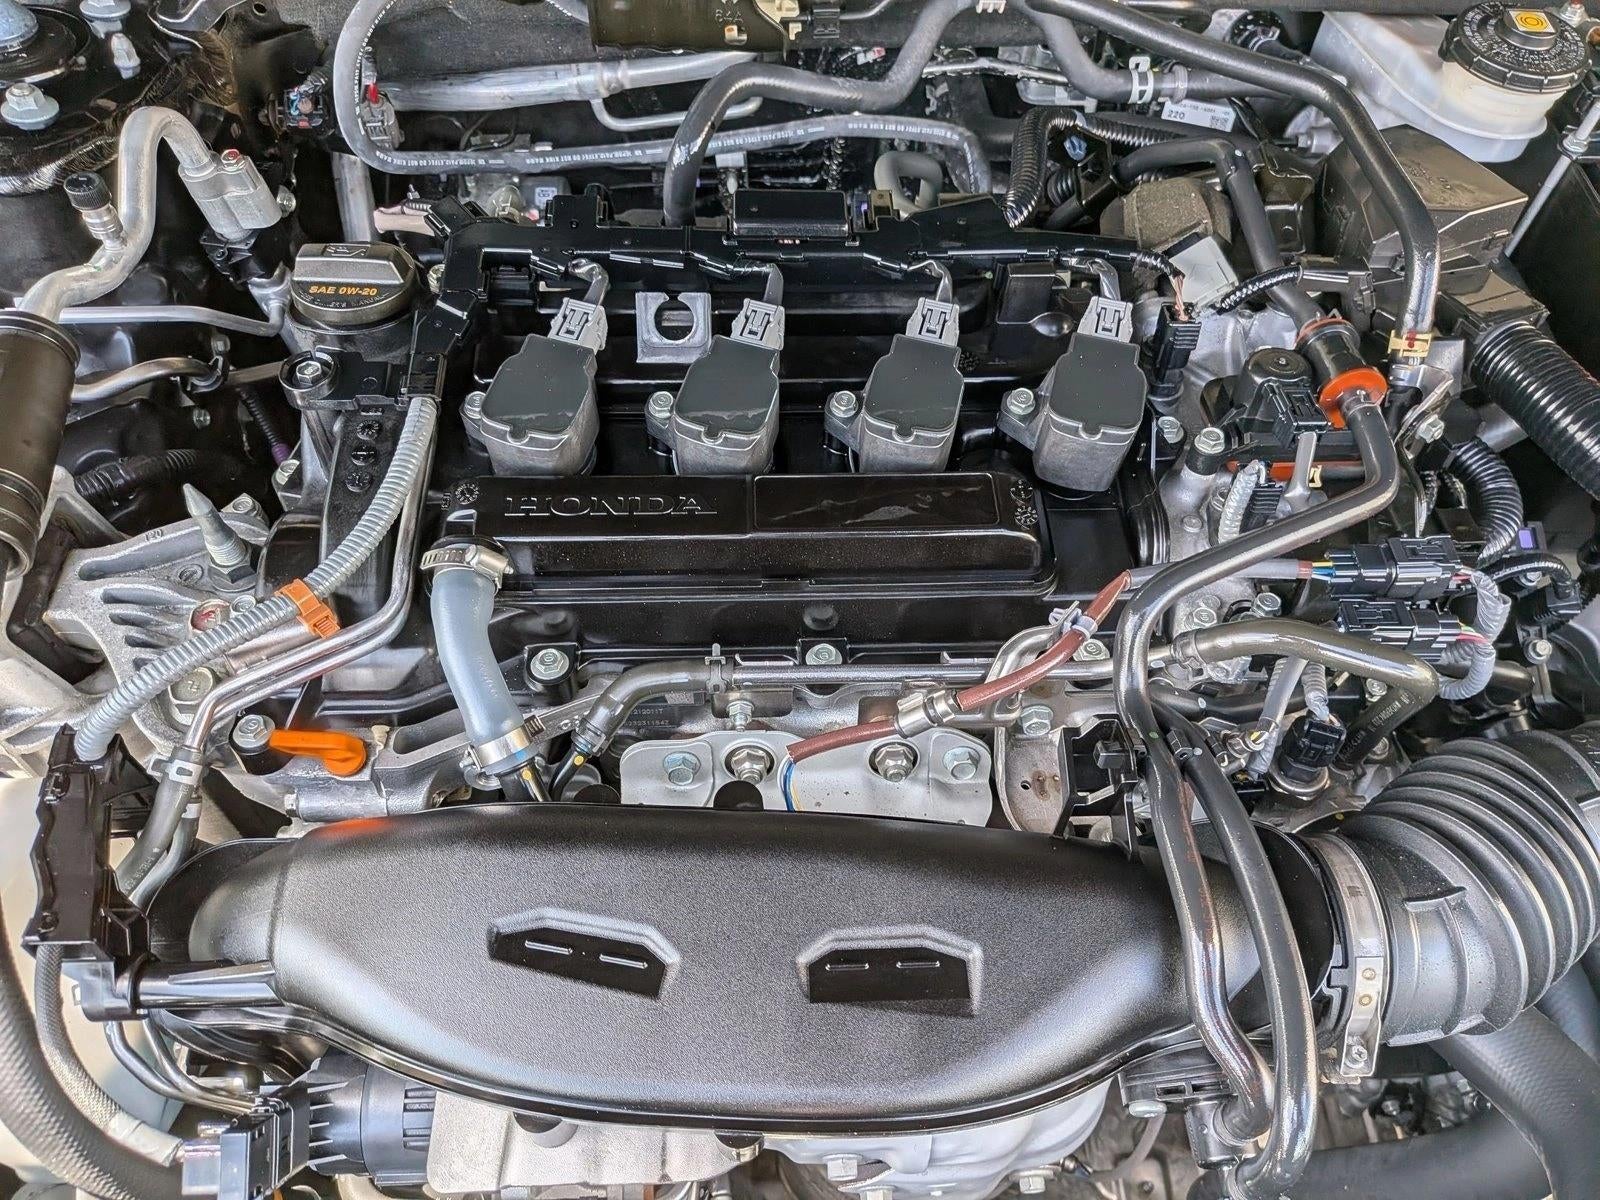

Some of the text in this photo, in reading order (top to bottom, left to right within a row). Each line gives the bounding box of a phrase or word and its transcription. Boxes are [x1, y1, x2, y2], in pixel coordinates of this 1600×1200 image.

[308, 285, 378, 296] SAE 0W-20
[504, 496, 718, 516] HONDA
